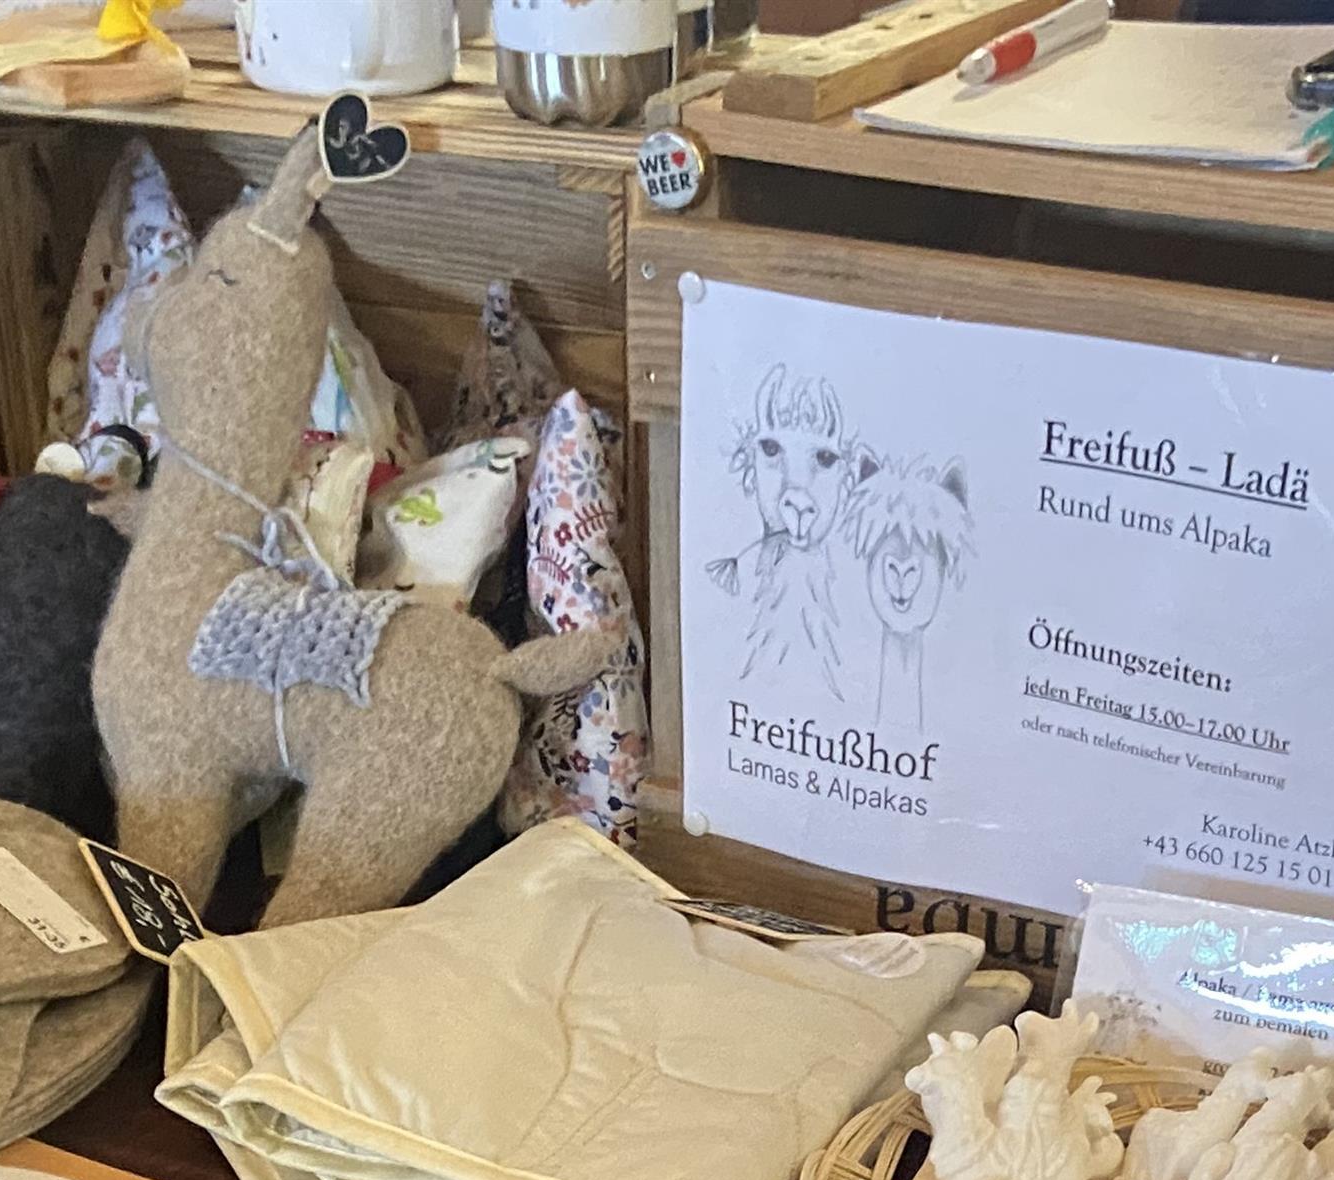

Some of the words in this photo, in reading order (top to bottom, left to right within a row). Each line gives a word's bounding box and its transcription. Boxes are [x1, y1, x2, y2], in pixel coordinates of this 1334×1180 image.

[639, 153, 670, 176] WE
[647, 172, 692, 196] BEER
[1042, 419, 1177, 477] Freifuß
[1220, 451, 1310, 503] Ladä
[1038, 485, 1111, 524] Rund
[1121, 506, 1173, 536] ums
[1180, 511, 1273, 558] Alpaka
[1028, 617, 1232, 693] Öffnungszeiten:
[728, 700, 940, 782] Freifußhof
[1023, 676, 1069, 700] jeden
[1076, 686, 1132, 719] Freitag
[1252, 727, 1291, 752] Uhr
[728, 748, 800, 790] Lamas
[805, 770, 821, 795] &
[827, 777, 929, 816] Alpakas
[1021, 717, 1053, 735] oder
[1057, 726, 1089, 744] nach
[1093, 732, 1181, 766] telefonischer
[1185, 752, 1287, 790] Vereinbarung
[1142, 835, 1178, 857] +43
[1185, 842, 1224, 866] 660
[1232, 850, 1268, 875] 125
[1276, 859, 1301, 882] 15
[1308, 865, 1333, 888] 01
[1201, 814, 1290, 849] Karoline
[149, 874, 199, 941] Sohl
[1213, 1008, 1251, 1027] zum
